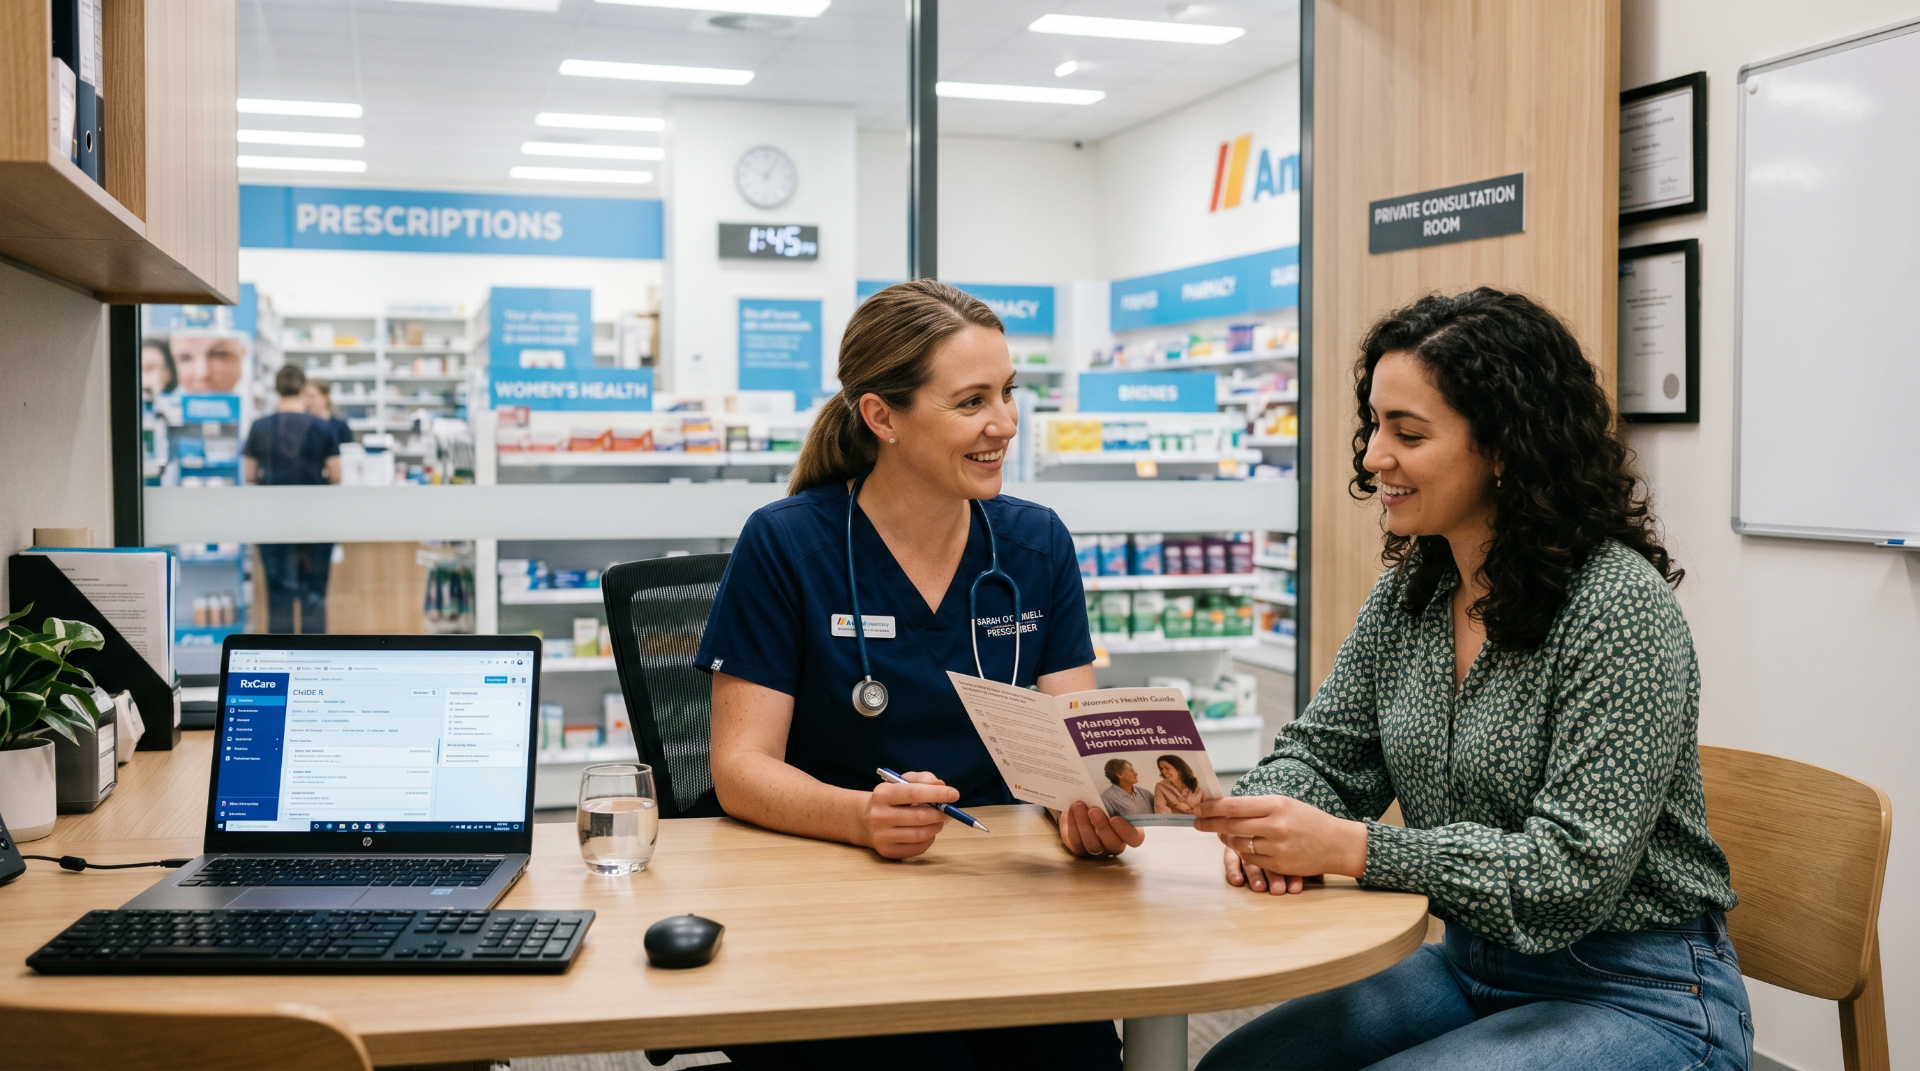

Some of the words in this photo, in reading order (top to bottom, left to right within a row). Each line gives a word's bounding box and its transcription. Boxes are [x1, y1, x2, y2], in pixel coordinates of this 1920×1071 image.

[1374, 202, 1420, 225] PRIVATE
[1422, 184, 1515, 216] CONSULTATION
[297, 203, 563, 241] PRESCRIPTIONS
[1423, 216, 1460, 237] ROOM
[748, 226, 801, 256] 1:45
[495, 380, 578, 399] WOMEN'S
[580, 381, 648, 399] HEALTH
[976, 616, 1001, 626] SARAH
[240, 679, 276, 688] RxCare
[1081, 697, 1118, 707] Women's
[1150, 695, 1176, 703] Guide
[1076, 716, 1140, 730] Managing
[1080, 727, 1154, 740] Menopause
[1156, 725, 1167, 735] &
[1085, 736, 1148, 750] Hormonal
[1149, 735, 1192, 745] Health
